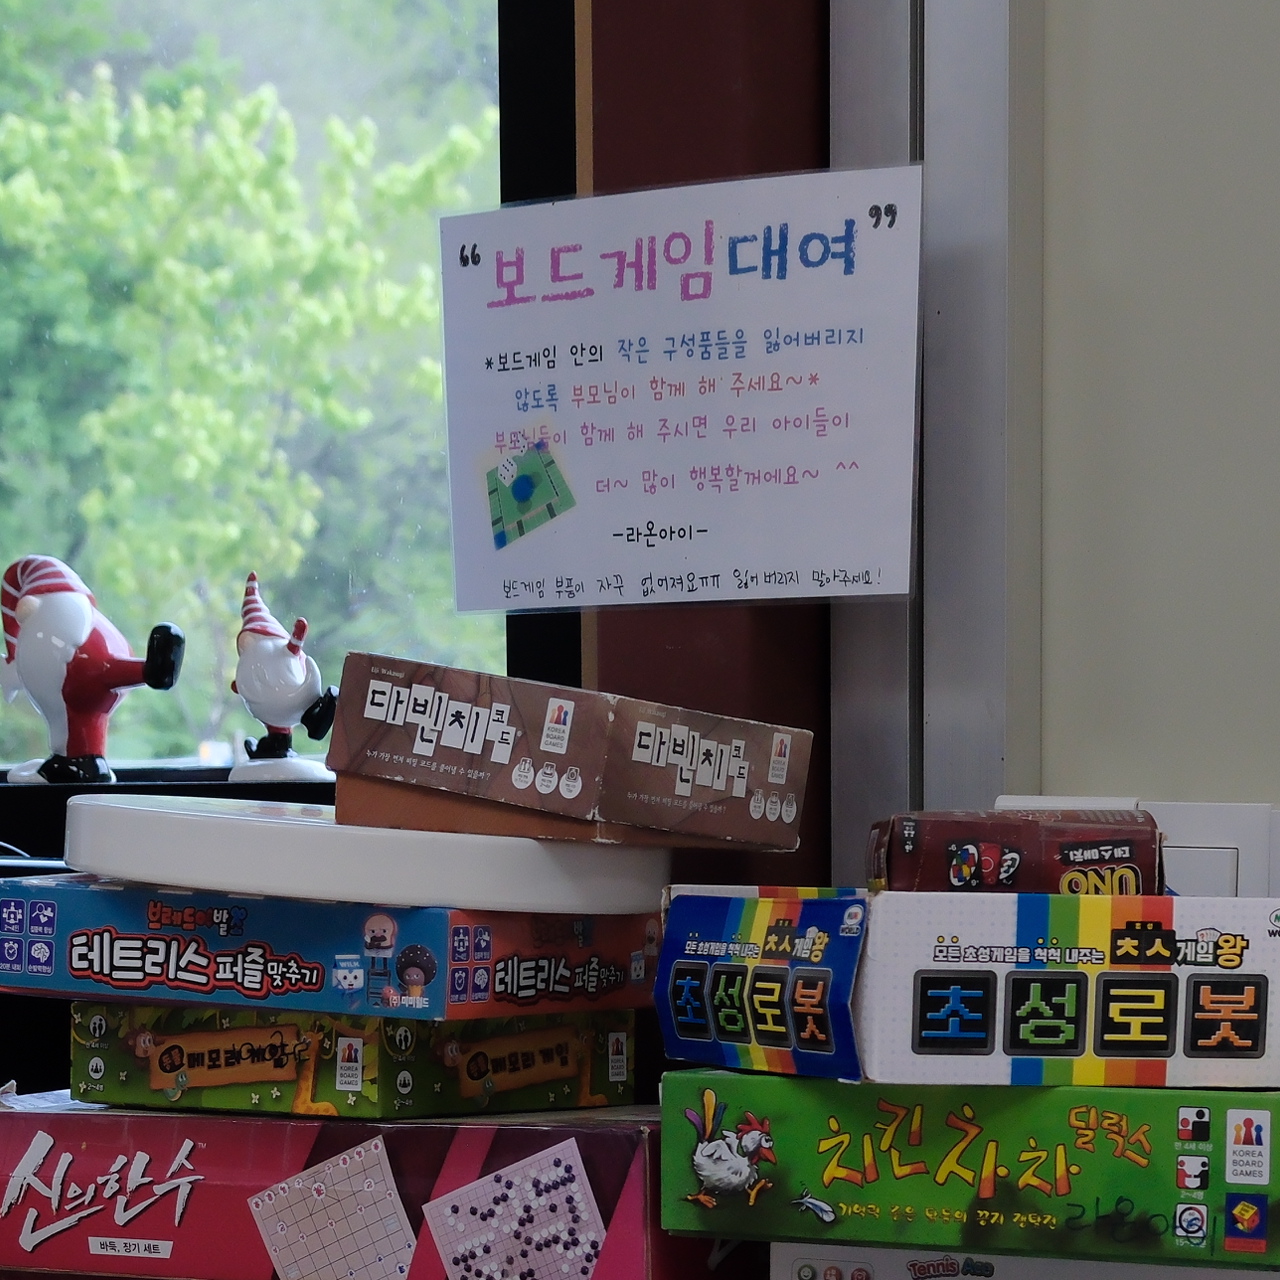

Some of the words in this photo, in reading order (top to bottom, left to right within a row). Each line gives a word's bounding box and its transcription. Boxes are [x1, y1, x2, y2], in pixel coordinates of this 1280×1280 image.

[571, 344, 604, 365] 안의
[618, 338, 650, 364] 작은
[664, 329, 747, 360] 구성품들을
[763, 327, 864, 353] 잃어버리지
[515, 384, 558, 412] 않도록
[572, 381, 635, 409] 부모님이
[650, 376, 686, 401] 함께
[698, 376, 717, 396] 해
[581, 422, 615, 446] 함께
[627, 422, 644, 440] 해
[657, 415, 708, 443] 주시면
[723, 415, 757, 439] 우리
[773, 407, 850, 437] 아이들이
[642, 469, 676, 495] 많이
[554, 577, 585, 598] 부품이
[598, 576, 625, 596] 자꾸
[545, 733, 565, 741] BOARD
[547, 726, 566, 734] KOREA
[544, 740, 563, 748] GAMES
[1059, 866, 1143, 895] UNO
[71, 932, 209, 984] 테트리스
[216, 947, 264, 990] 퍼즐
[267, 960, 317, 987] 맞추기
[933, 944, 962, 963] 모든
[963, 944, 1031, 963] 초성게임을
[1035, 945, 1062, 964] 척척
[1064, 946, 1105, 965] 내주는
[495, 956, 571, 997] 테트리스
[574, 957, 599, 992] 퍼즐
[600, 963, 624, 988] 맞추기
[1068, 1105, 1153, 1168] 딜럭스
[1232, 1149, 1263, 1158] KOREA
[1232, 1159, 1263, 1168] BOARD
[1232, 1169, 1263, 1178] GAMES
[100, 1241, 120, 1252] 바둑,
[123, 1242, 139, 1253] 장기
[144, 1243, 161, 1254] 세트
[906, 1255, 959, 1279] Tennis
